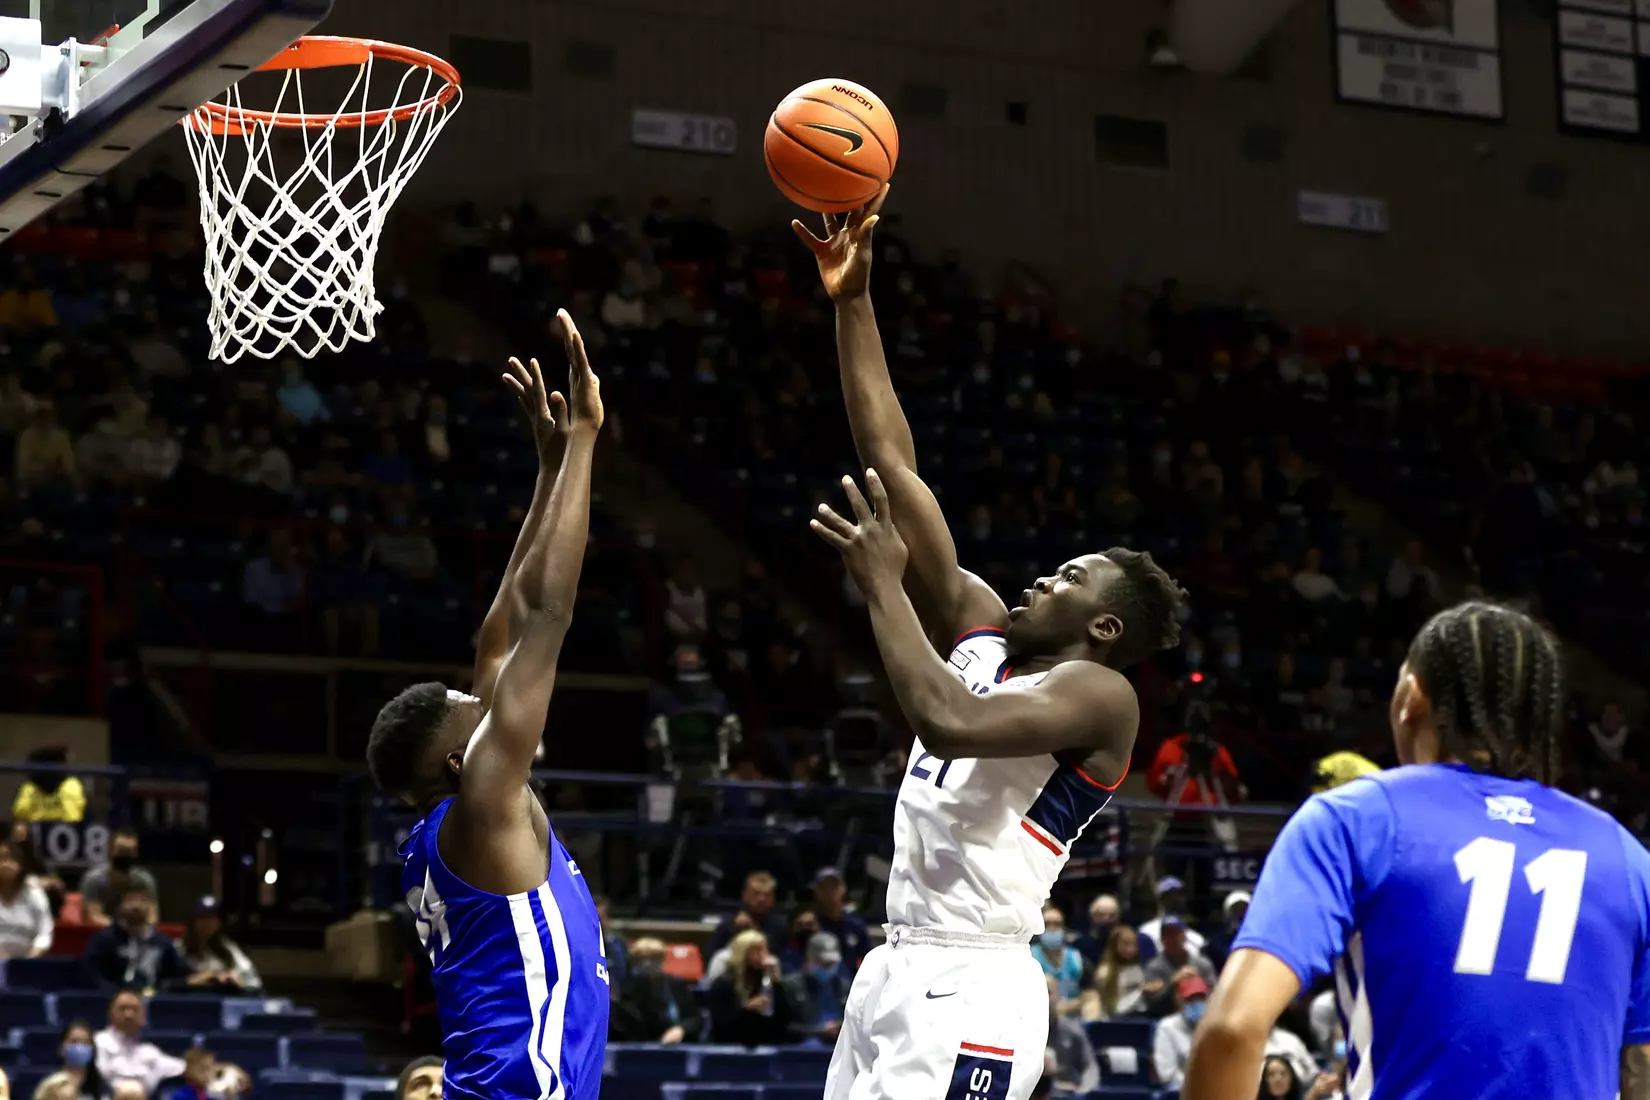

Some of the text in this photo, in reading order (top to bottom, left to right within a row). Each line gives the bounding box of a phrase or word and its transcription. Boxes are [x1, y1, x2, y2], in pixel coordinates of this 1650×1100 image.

[831, 85, 874, 111] UCONN
[681, 118, 736, 149] 210
[1214, 858, 1258, 880] SEC
[1453, 836, 1588, 985] 11
